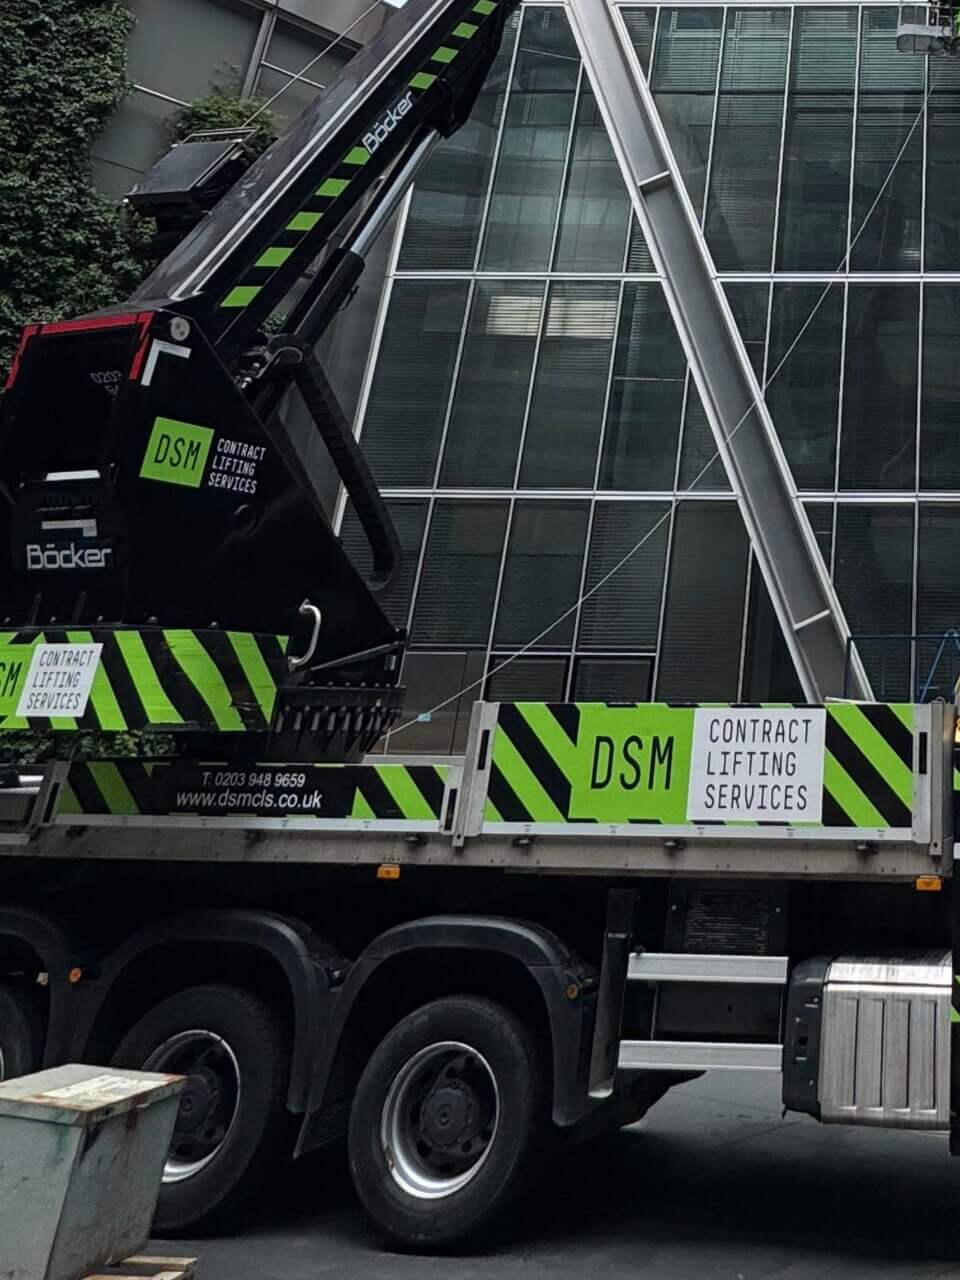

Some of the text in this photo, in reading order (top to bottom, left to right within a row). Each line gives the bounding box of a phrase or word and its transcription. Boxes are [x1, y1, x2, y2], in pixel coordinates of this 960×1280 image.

[362, 90, 413, 154] Böcker
[153, 433, 202, 471] DSM
[217, 438, 267, 461] CONTRACT
[211, 455, 256, 477] LIFTING
[207, 472, 258, 494] SERVICES
[26, 542, 112, 569] Böcker
[39, 650, 95, 667] CONTRACT
[33, 671, 81, 688] LIFTING
[27, 692, 81, 710] SERVICES
[709, 719, 812, 744] CONTRACT
[590, 735, 674, 790] DSM
[706, 751, 797, 776] LIFTING
[214, 772, 246, 787] 0203
[249, 772, 272, 787] 948
[274, 773, 306, 788] 9659
[176, 789, 323, 808] www.dsmcls.co.uk
[704, 784, 808, 810] SERVICES
